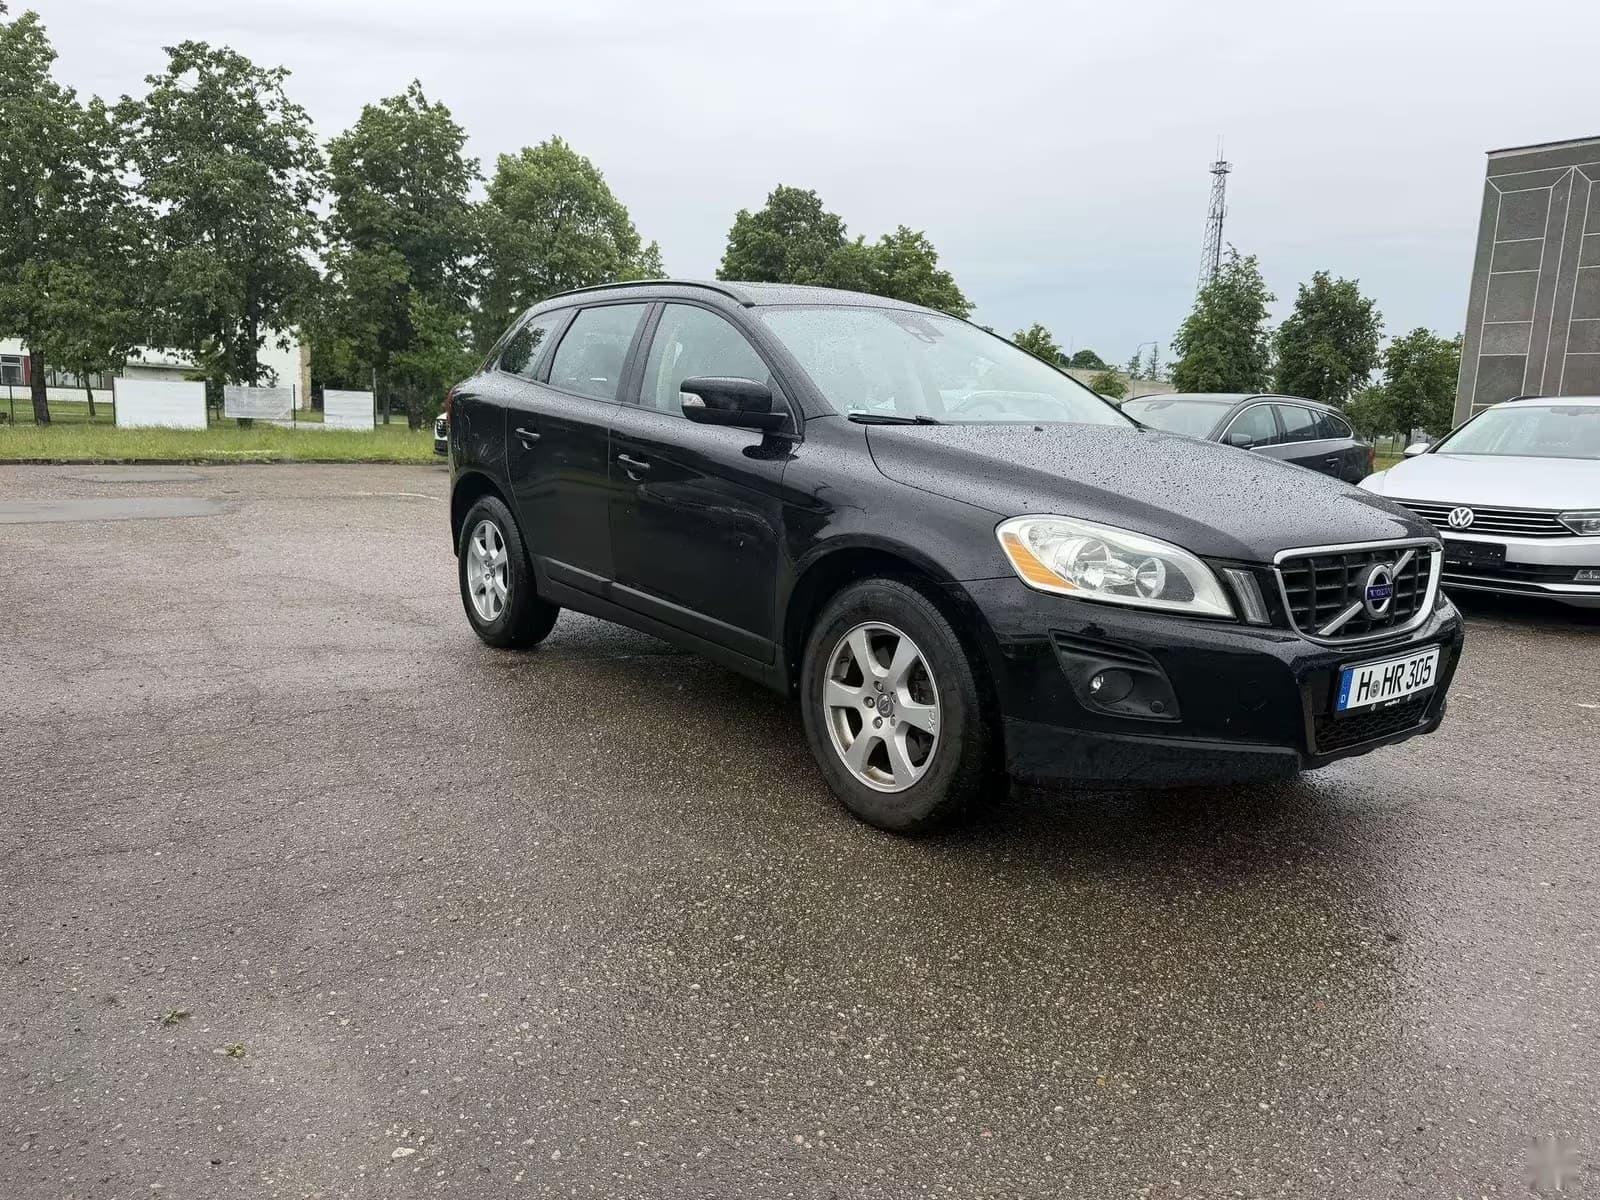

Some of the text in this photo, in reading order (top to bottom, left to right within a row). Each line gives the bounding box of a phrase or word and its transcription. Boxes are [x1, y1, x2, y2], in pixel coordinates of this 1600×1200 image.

[1357, 655, 1434, 702] H HR 305
